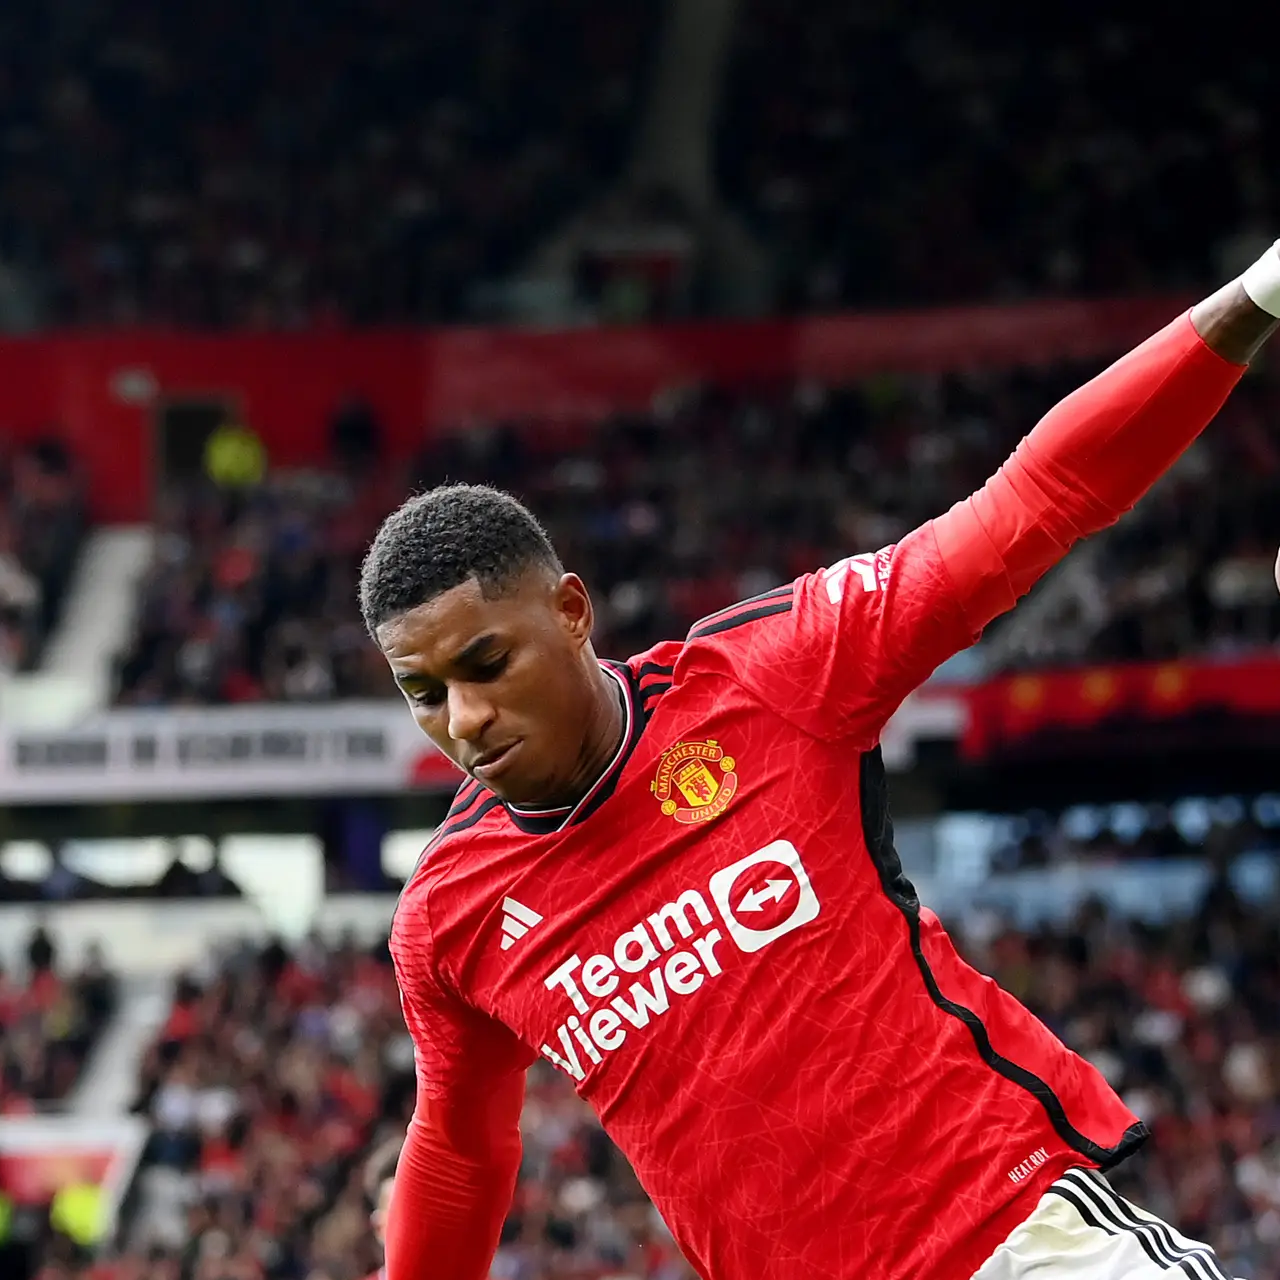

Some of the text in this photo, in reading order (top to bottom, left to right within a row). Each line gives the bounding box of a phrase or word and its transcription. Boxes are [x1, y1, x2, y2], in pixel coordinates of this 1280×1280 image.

[659, 745, 716, 793] MANCHESTER
[691, 788, 732, 820] UNITED
[544, 889, 714, 1015] Team
[541, 928, 722, 1082] Viewer
[1007, 1146, 1050, 1184] HEAT.RDY
